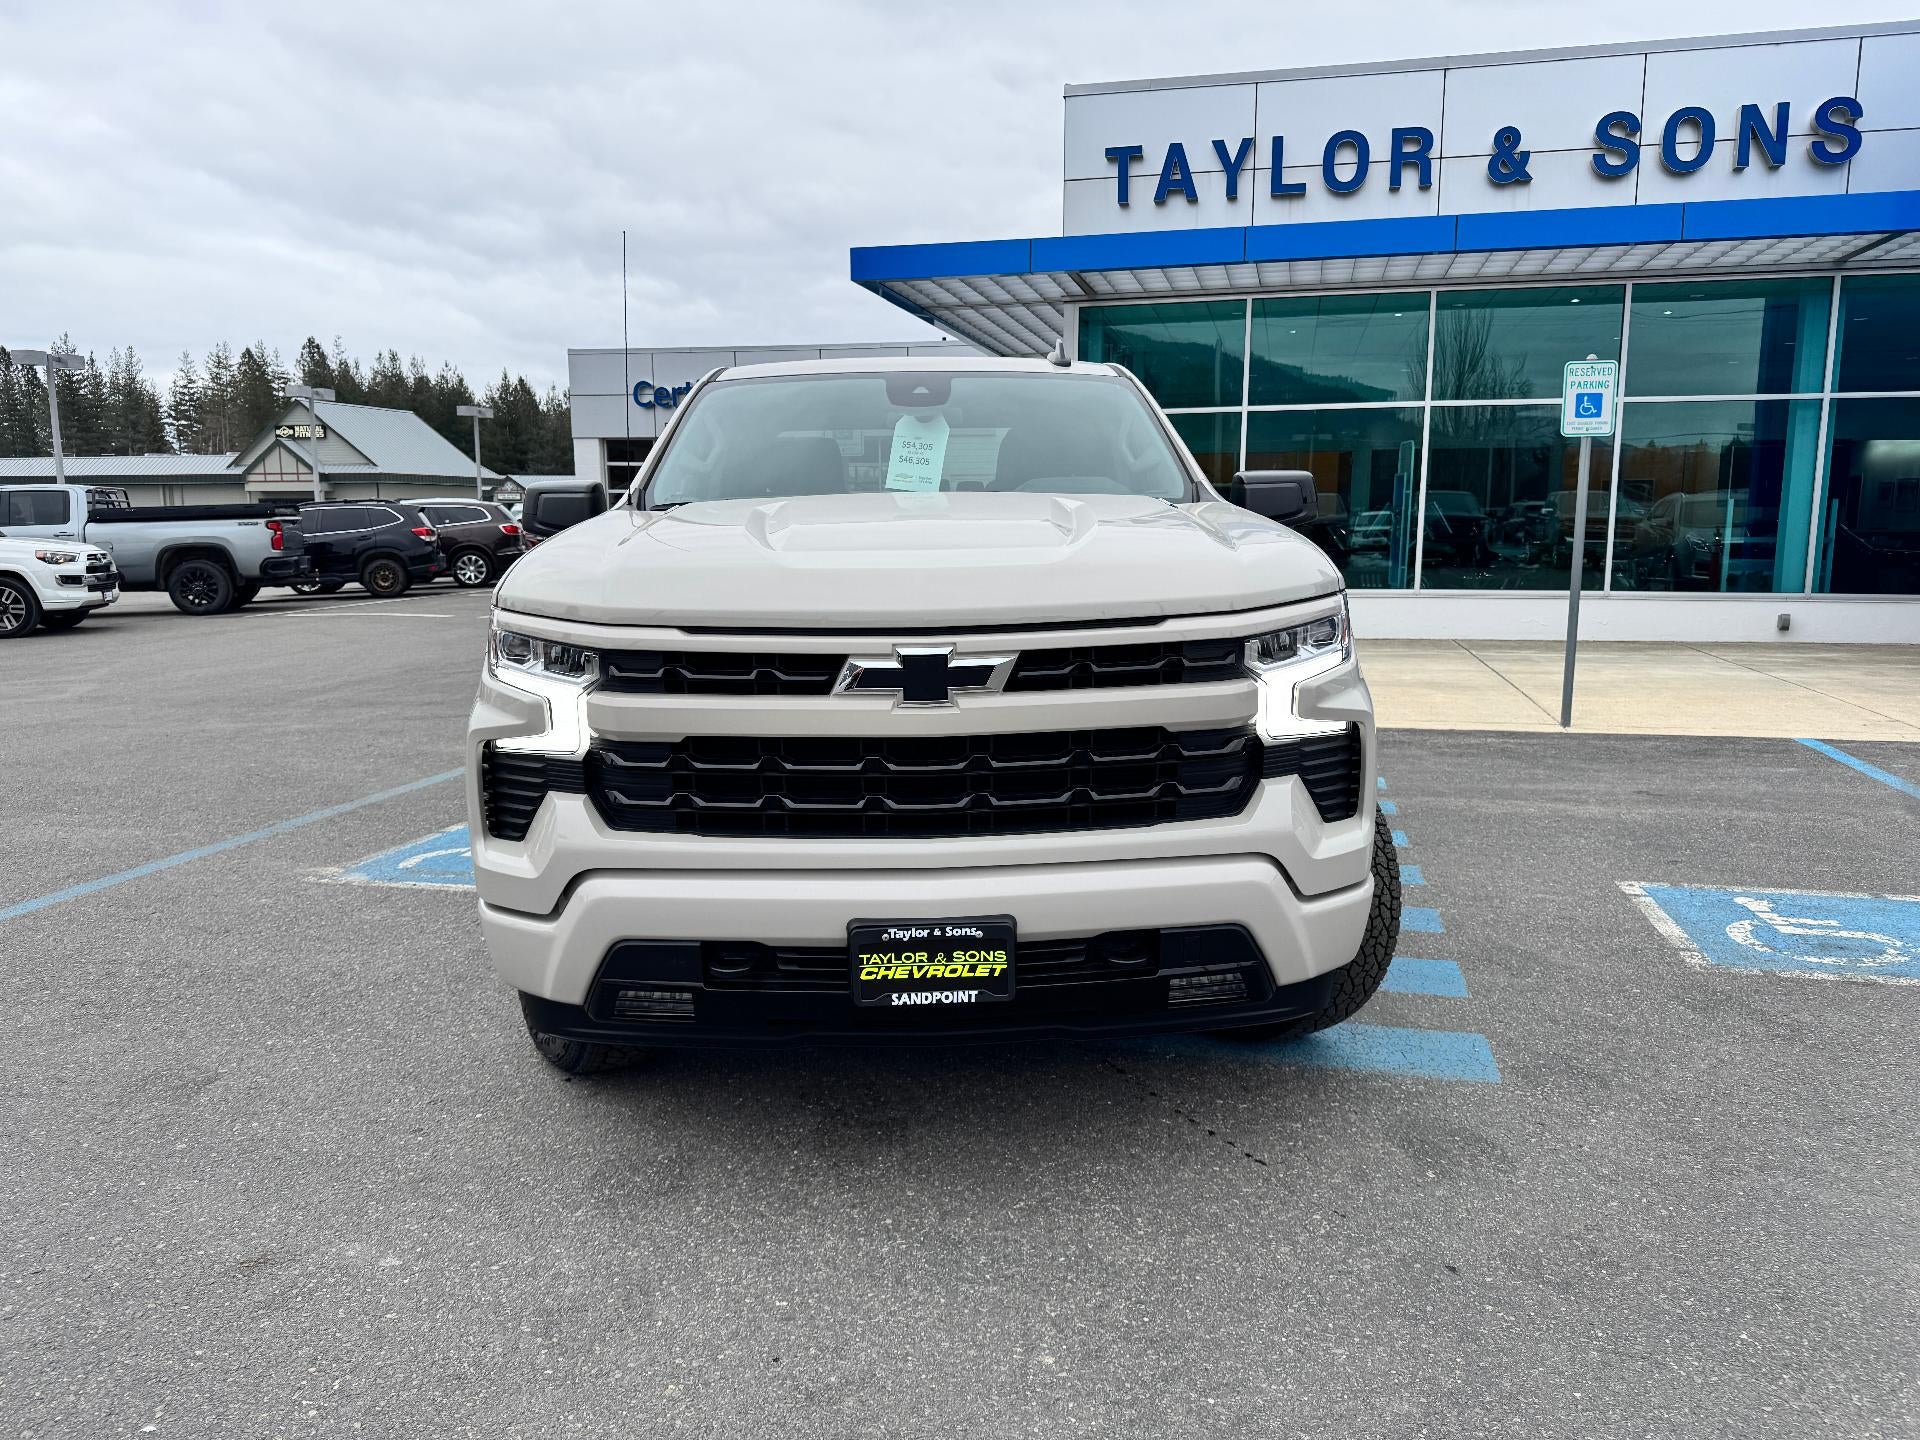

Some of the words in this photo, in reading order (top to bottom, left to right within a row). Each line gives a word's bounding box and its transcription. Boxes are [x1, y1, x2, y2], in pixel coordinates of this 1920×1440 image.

[1104, 127, 1435, 206] TAYLOR
[1487, 125, 1534, 186] &
[1591, 95, 1865, 178] SONS
[1569, 366, 1613, 377] RESERVED
[1570, 380, 1610, 390] PARKING
[632, 379, 700, 409] Cert
[901, 440, 933, 451] $54,305
[887, 927, 931, 941] Taylor
[933, 928, 942, 936] &
[945, 926, 977, 937] Sons
[858, 952, 928, 965] TAYLOR
[934, 952, 947, 964] &
[952, 950, 1007, 962] SONS
[859, 964, 1008, 981] CHEVROLET
[891, 990, 979, 1006] SANDPOINT
